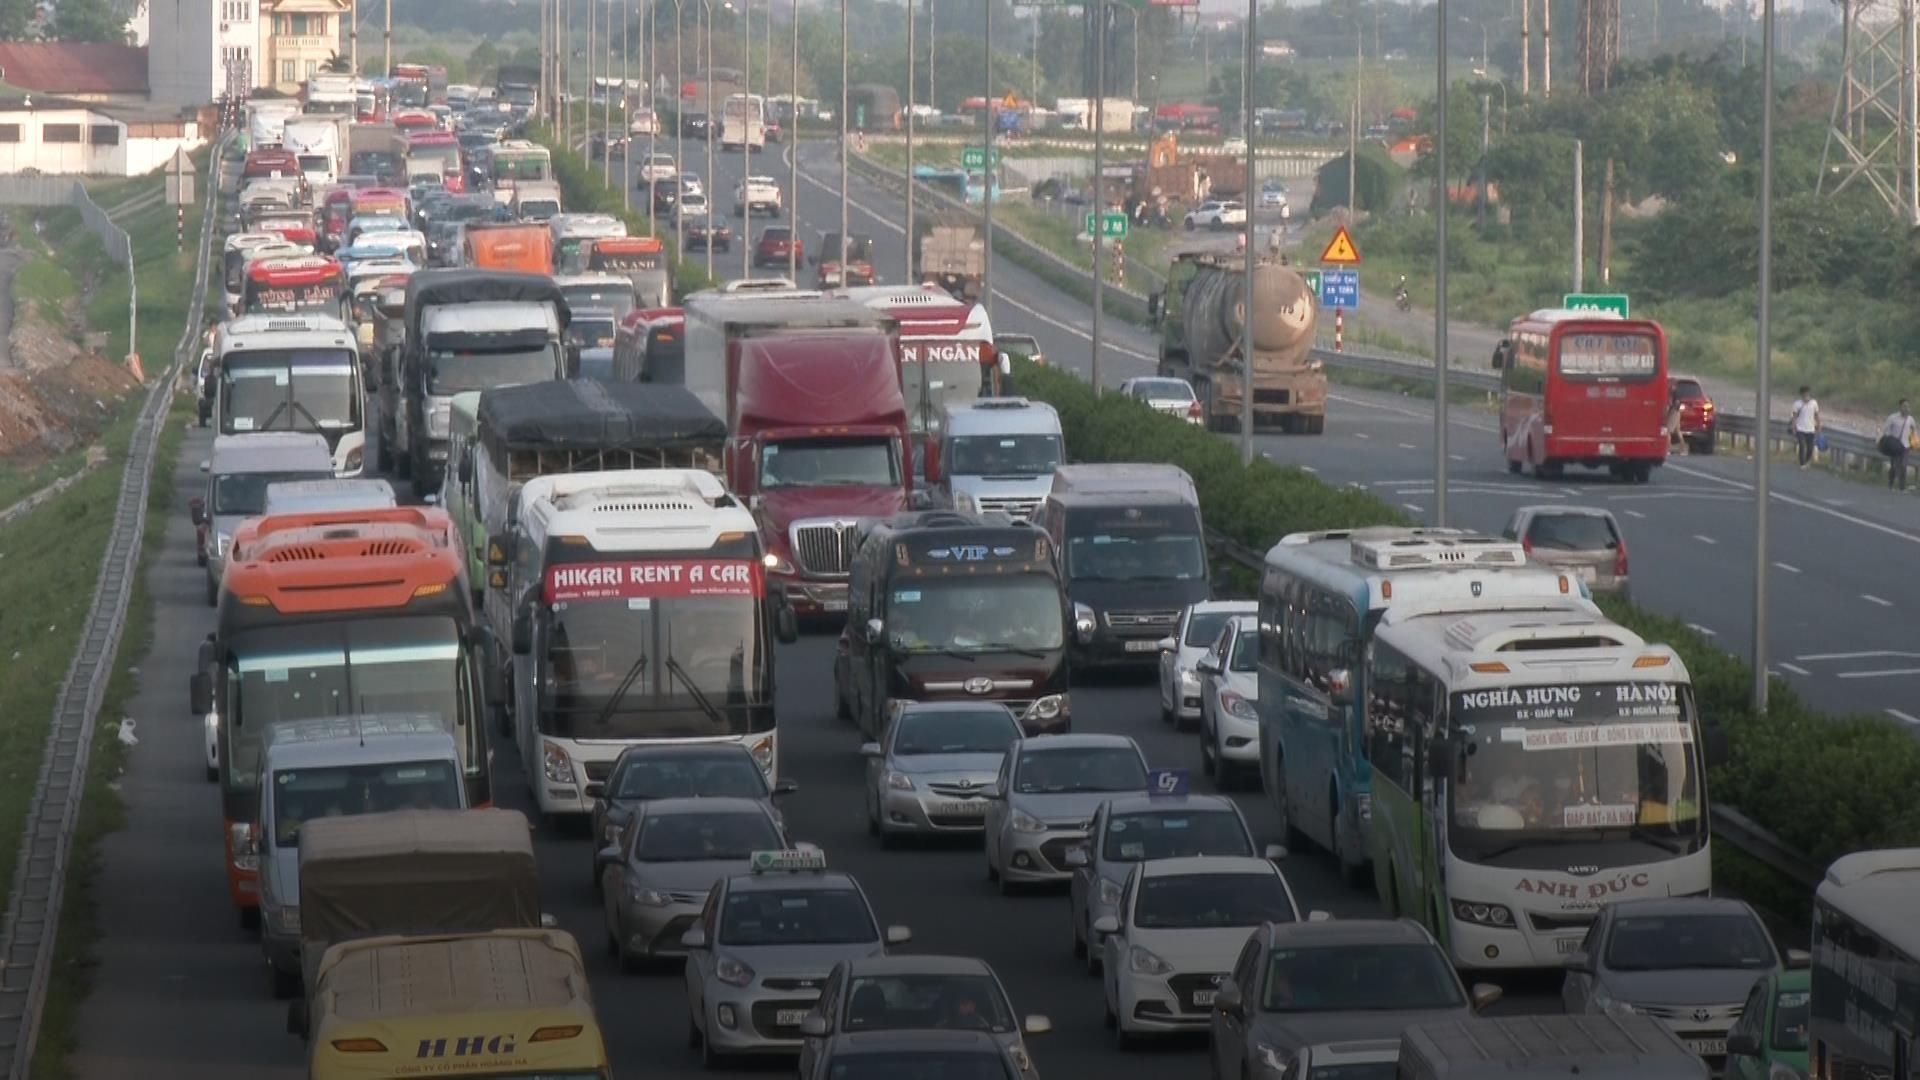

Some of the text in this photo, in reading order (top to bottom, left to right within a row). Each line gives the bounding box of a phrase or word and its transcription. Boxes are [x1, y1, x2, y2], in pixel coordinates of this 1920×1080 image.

[927, 343, 980, 362] NGÂN
[950, 545, 989, 561] VIP
[554, 565, 750, 589] HIKARI RENT A CAR
[1462, 681, 1677, 710] NGHĨA HƯNG HÀ NỘI
[1158, 772, 1179, 792] G7
[1515, 873, 1649, 898] ANH ĐỨC
